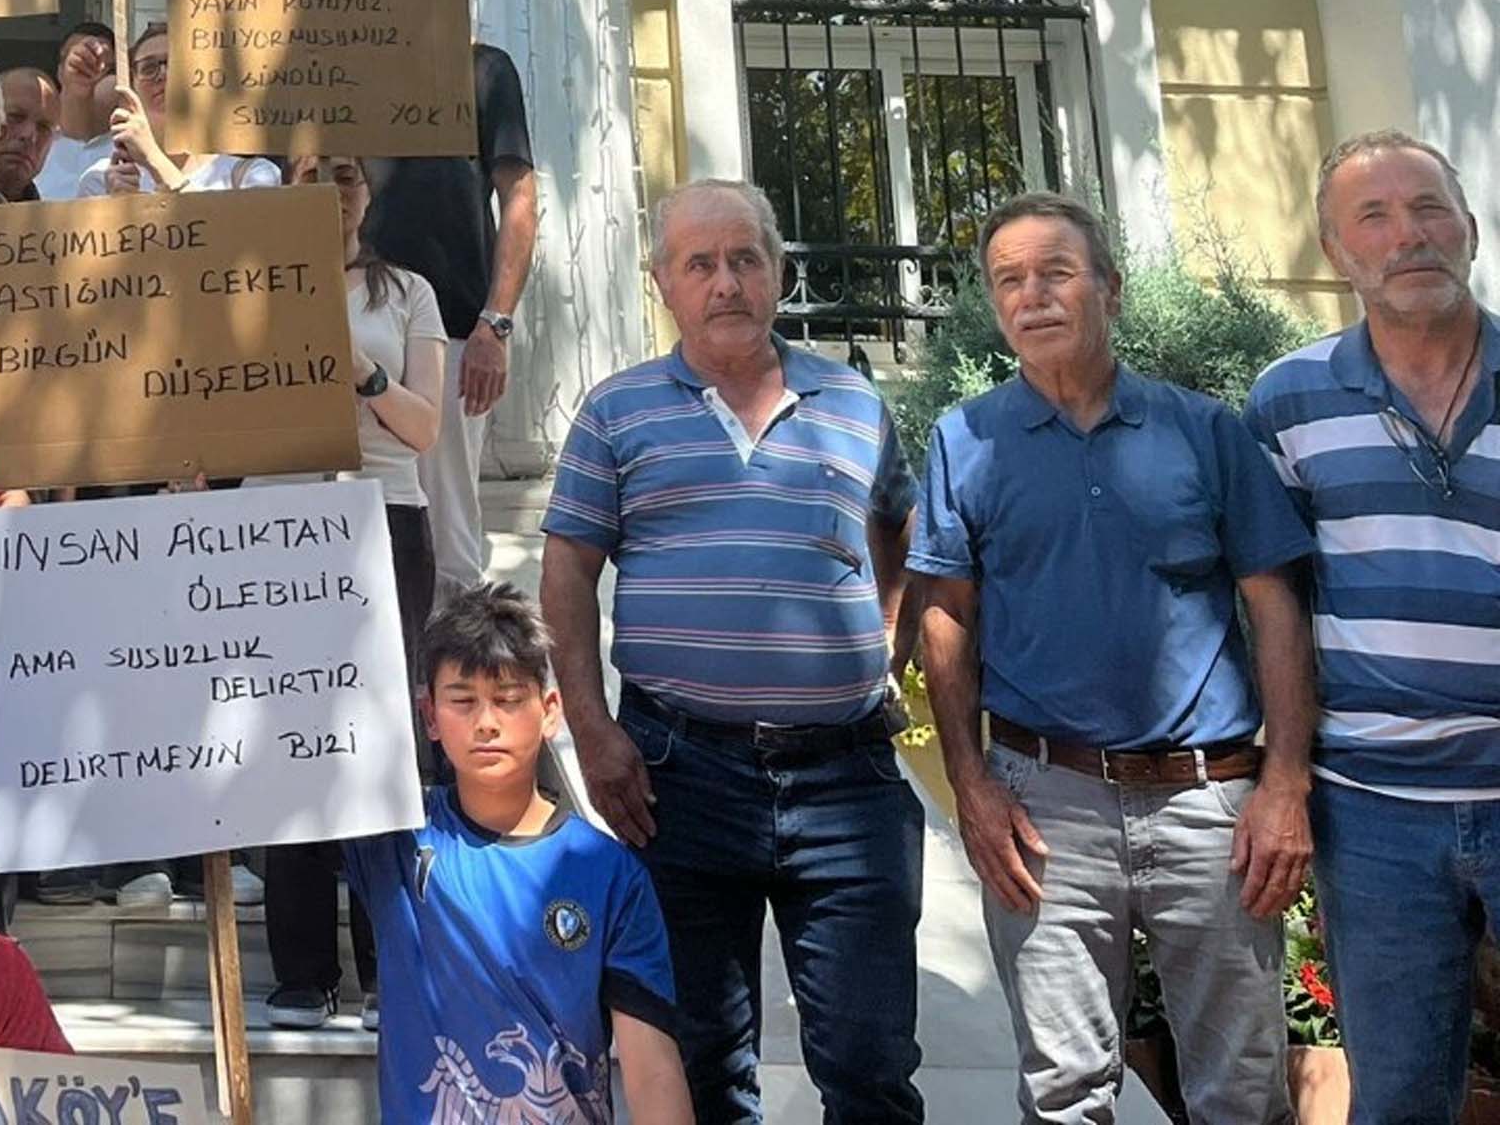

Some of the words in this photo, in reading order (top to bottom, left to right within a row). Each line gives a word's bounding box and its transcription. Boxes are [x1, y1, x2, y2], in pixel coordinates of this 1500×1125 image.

[192, 68, 226, 89] 20
[9, 649, 77, 679] AMA
[105, 635, 273, 671] SUSUZLUK
